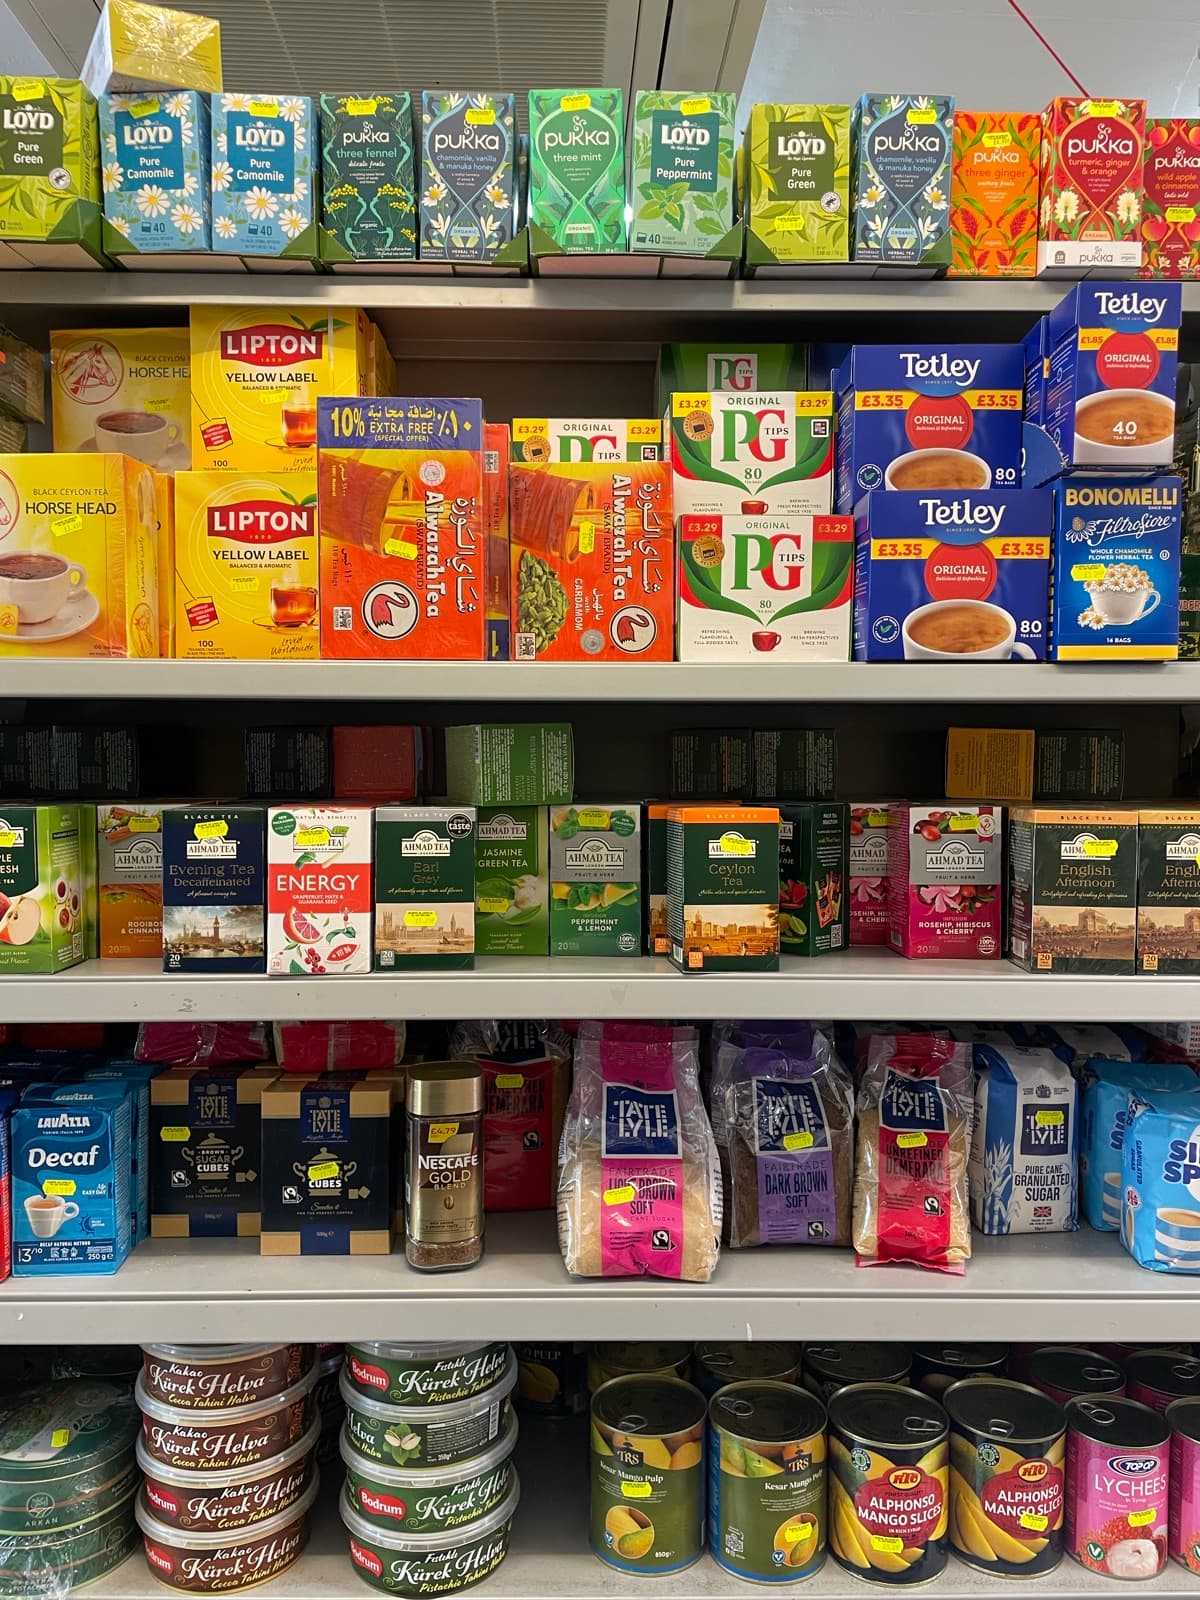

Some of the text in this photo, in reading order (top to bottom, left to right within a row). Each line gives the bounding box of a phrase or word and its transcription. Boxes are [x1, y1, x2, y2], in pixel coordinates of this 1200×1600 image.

[4, 108, 54, 130] LOYD
[124, 126, 172, 146] LOYD
[236, 129, 285, 148] LOYD
[343, 127, 389, 146] pukka
[435, 129, 499, 152] pukka
[661, 125, 710, 144] LOYD
[336, 148, 396, 157] three fennel
[777, 136, 826, 156] LOYD
[140, 157, 160, 166] Pure
[553, 154, 578, 162] three
[675, 157, 695, 166] Pure
[657, 168, 712, 180] Peppermint
[965, 169, 1026, 179] three ginger
[1082, 167, 1117, 177] & orange
[1176, 174, 1197, 184] apple
[787, 180, 815, 189] Green
[648, 235, 660, 244] 40
[1094, 292, 1167, 323] Tetley
[226, 335, 316, 355] LIPTON
[713, 359, 752, 390] PG
[900, 353, 981, 386] Tetley
[226, 373, 318, 383] YELLOW LABEL
[727, 397, 780, 405] ORIGINAL
[977, 394, 1017, 407] £3.35
[408, 405, 436, 421] إضافة
[331, 407, 365, 437] 10%
[720, 409, 789, 462] PG
[995, 468, 1016, 481] 80
[60, 488, 90, 496] CEYLON
[93, 488, 109, 496] TEA
[1066, 488, 1178, 506] BONOMELLI
[25, 502, 117, 515] HORSE HEAD
[214, 512, 307, 531] LIPTON
[919, 499, 1006, 534] Tetley
[613, 474, 632, 600] Alwazah Tea
[1087, 513, 1172, 546] Filtrofiore
[425, 491, 446, 617] Alwazah Tea
[778, 554, 805, 562] TIPS
[731, 534, 804, 591] PG
[760, 600, 772, 608] 80
[188, 844, 236, 853] AHMAD TEA
[483, 848, 523, 857] JASMINE
[1168, 846, 1198, 854] AHMAD
[478, 859, 528, 867] GREEN TEA
[709, 864, 755, 876] Ceylon
[1060, 865, 1111, 876] English
[277, 875, 360, 891] ENERGY
[722, 876, 743, 886] Tea
[1056, 878, 1115, 887] Afternoon
[614, 1100, 666, 1119] TATE
[38, 1113, 91, 1128] LAVAZZA
[619, 1117, 668, 1137] LYLE
[431, 1127, 456, 1135] £4.79
[28, 1145, 100, 1168] Decaf
[195, 1155, 230, 1163] SUGAR
[886, 1144, 943, 1161] UNREFINED
[197, 1164, 229, 1172] CUBES
[418, 1154, 479, 1169] NESCAFÉ
[429, 1170, 471, 1184] GOLD
[609, 1168, 675, 1176] FAIRTRADE
[886, 1159, 944, 1181] DEMERARA
[1025, 1165, 1063, 1174] PURE CANE
[309, 1180, 342, 1188] CUBES
[765, 1171, 828, 1195] DARK BROWN
[1015, 1173, 1070, 1186] GRANULATED
[1025, 1188, 1060, 1201] SUGAR
[630, 1201, 654, 1214] SOFT
[169, 1364, 203, 1377] Kakao
[352, 1361, 386, 1386] Bodrum
[399, 1353, 505, 1395] Kürek Helva
[150, 1364, 265, 1397] Kürek Helva
[151, 1427, 269, 1459] Kürek Helva
[617, 1450, 639, 1465] TRS
[788, 1458, 809, 1472] TRS
[998, 1484, 1059, 1501] ALPHONSO
[1095, 1474, 1166, 1497] LYCHEES
[188, 1474, 304, 1520] Kürek Helva
[361, 1492, 403, 1515] Bodrum
[869, 1494, 935, 1511] ALPHONSO
[416, 1492, 475, 1519] Kürek
[858, 1502, 941, 1526] MANGO SLICES
[25, 1518, 58, 1527] ARKAN
[182, 1535, 300, 1581] Kürek Helva
[391, 1541, 503, 1584] Kürek Helva
